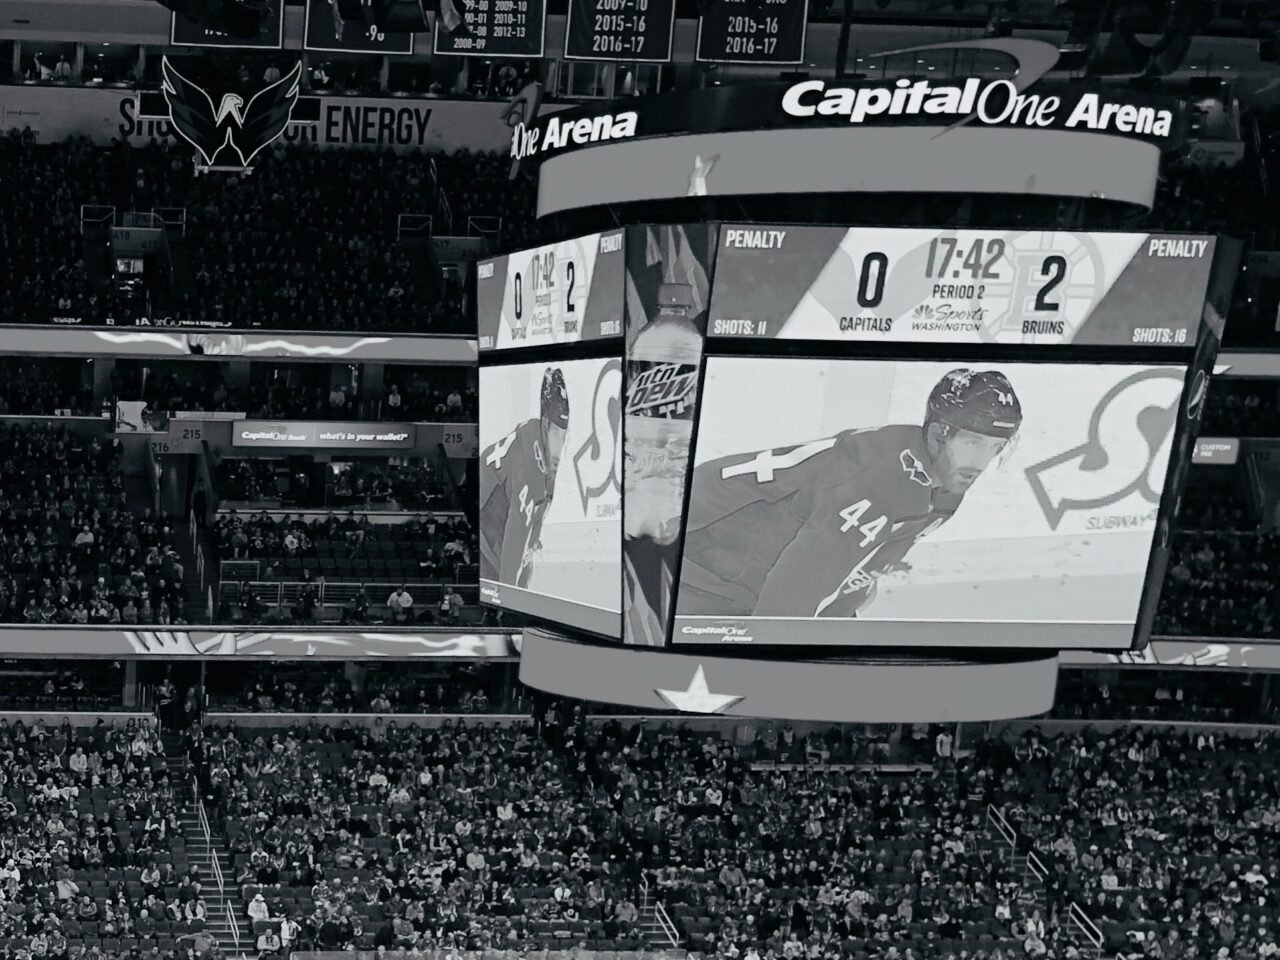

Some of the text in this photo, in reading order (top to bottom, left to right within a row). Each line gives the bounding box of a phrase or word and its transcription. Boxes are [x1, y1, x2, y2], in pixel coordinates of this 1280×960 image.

[493, 26, 526, 37] 2012-13
[594, 15, 646, 32] 2015-16
[728, 16, 778, 34] 2015-16
[592, 35, 645, 53] 2016-17
[725, 37, 777, 54] 2016-17
[1065, 92, 1173, 137] Arena
[326, 106, 432, 145] ENERGY
[540, 111, 638, 151] Arena
[725, 229, 1208, 279] PENALTY 17:42 PENALTY
[857, 251, 1067, 311] 0 2
[515, 272, 522, 320] 0
[567, 261, 575, 312] 2
[932, 285, 986, 299] PERIOD 2
[714, 320, 767, 334] SHOTS: 11
[839, 316, 1065, 335] CAPITALS WASHINGTON BRUINS
[1132, 328, 1187, 343] SHOTS: 16
[183, 429, 201, 440] 215
[320, 432, 345, 440] what's
[347, 432, 354, 440] in
[355, 434, 375, 442] your
[445, 433, 462, 443] 215
[151, 442, 168, 452] 216
[837, 498, 888, 548] 44
